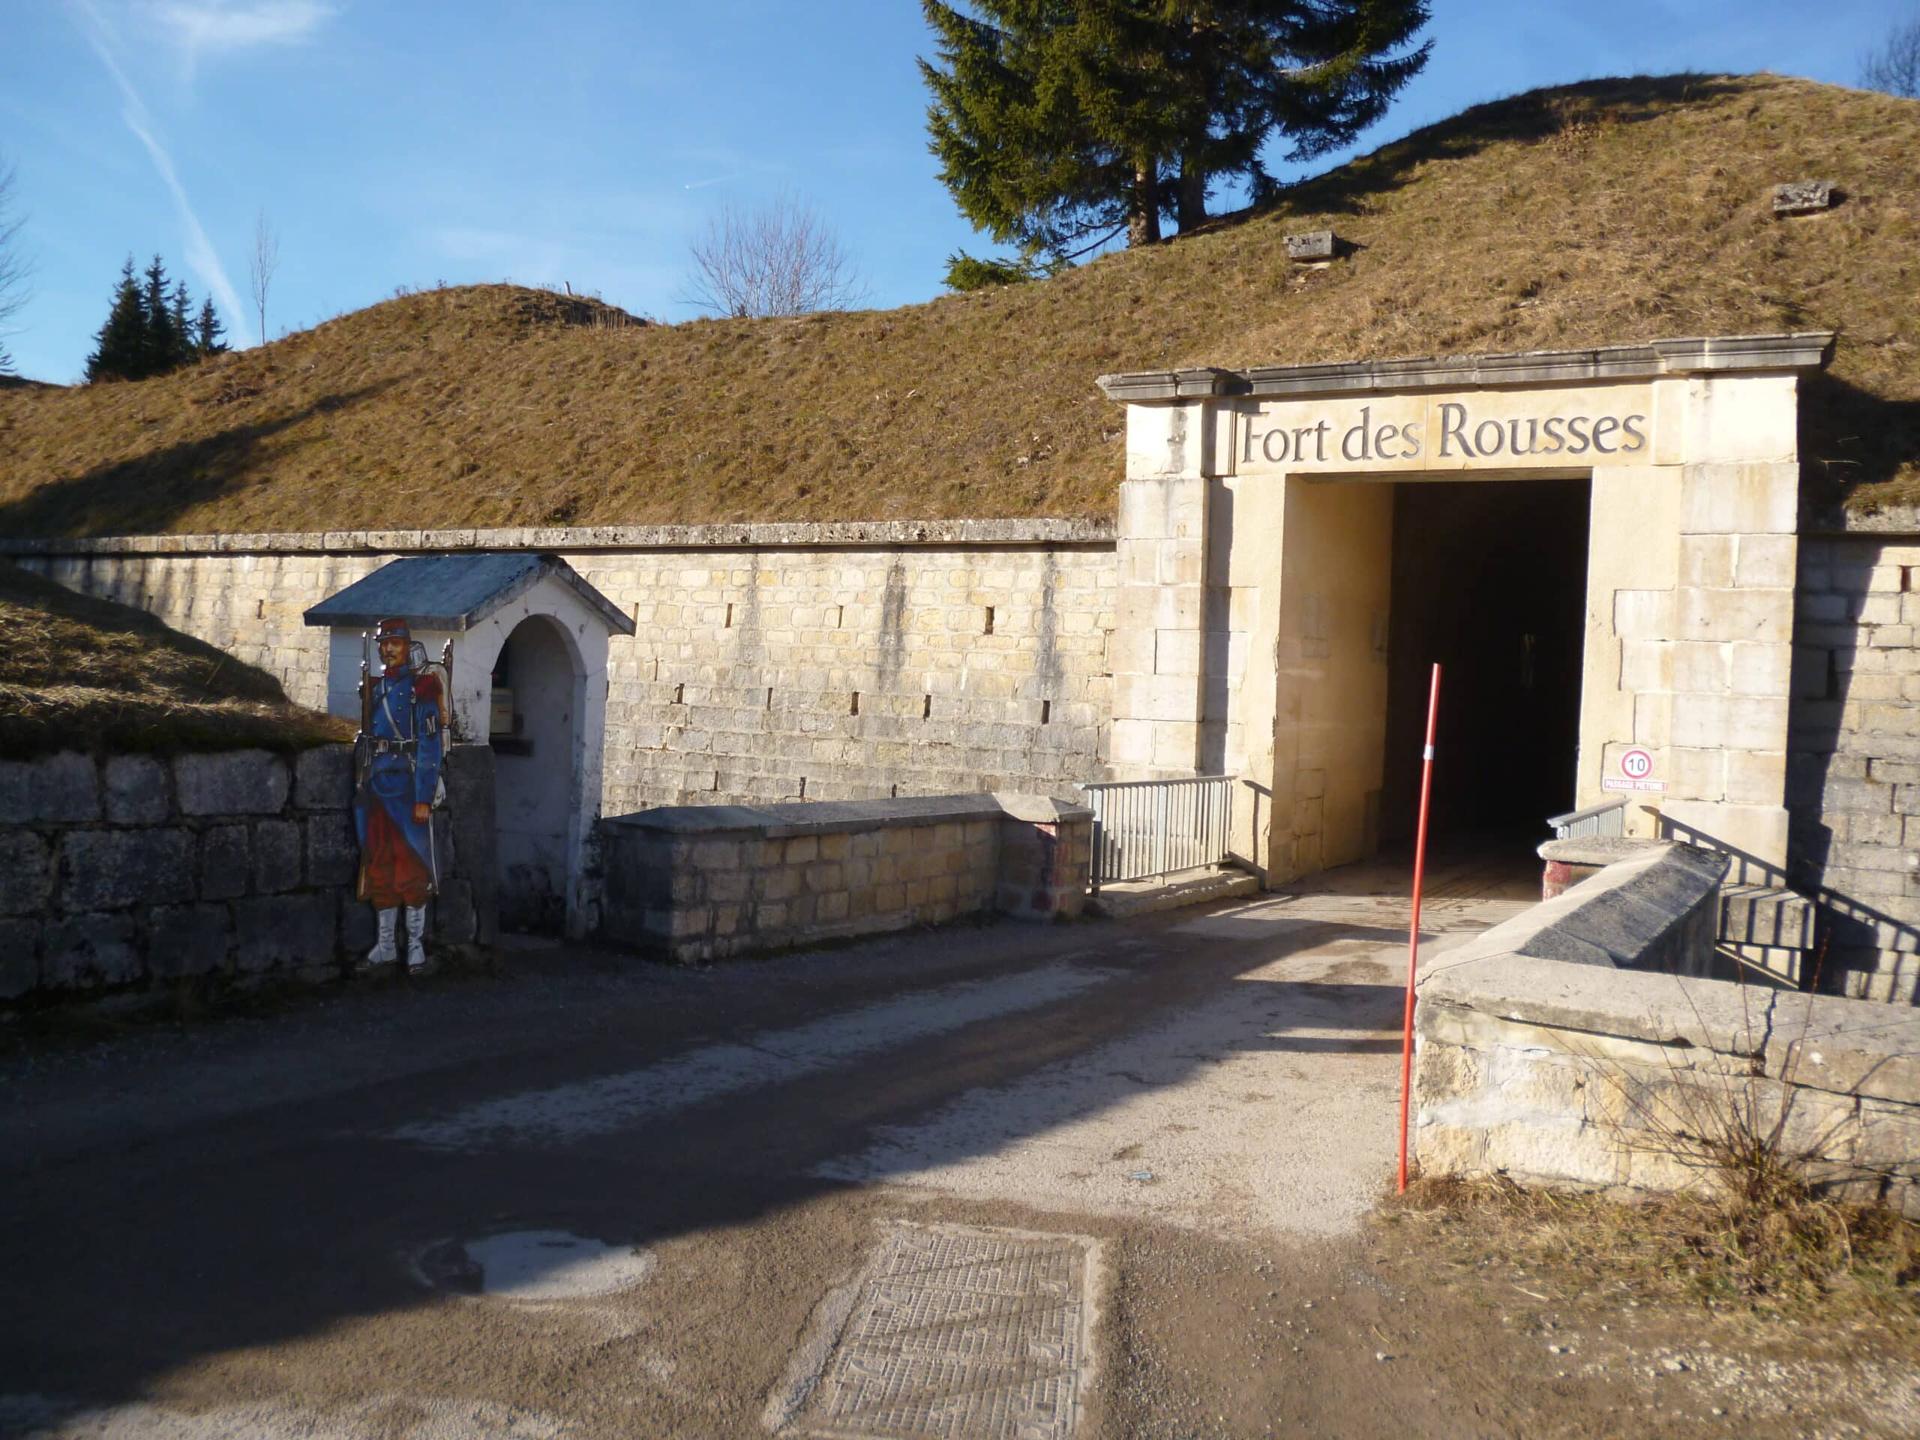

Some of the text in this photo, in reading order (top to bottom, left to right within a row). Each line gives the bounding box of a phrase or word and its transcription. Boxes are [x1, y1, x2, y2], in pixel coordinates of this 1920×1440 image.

[1241, 402, 1647, 464] Fort des Rousses
[1628, 758, 1646, 772] 10
